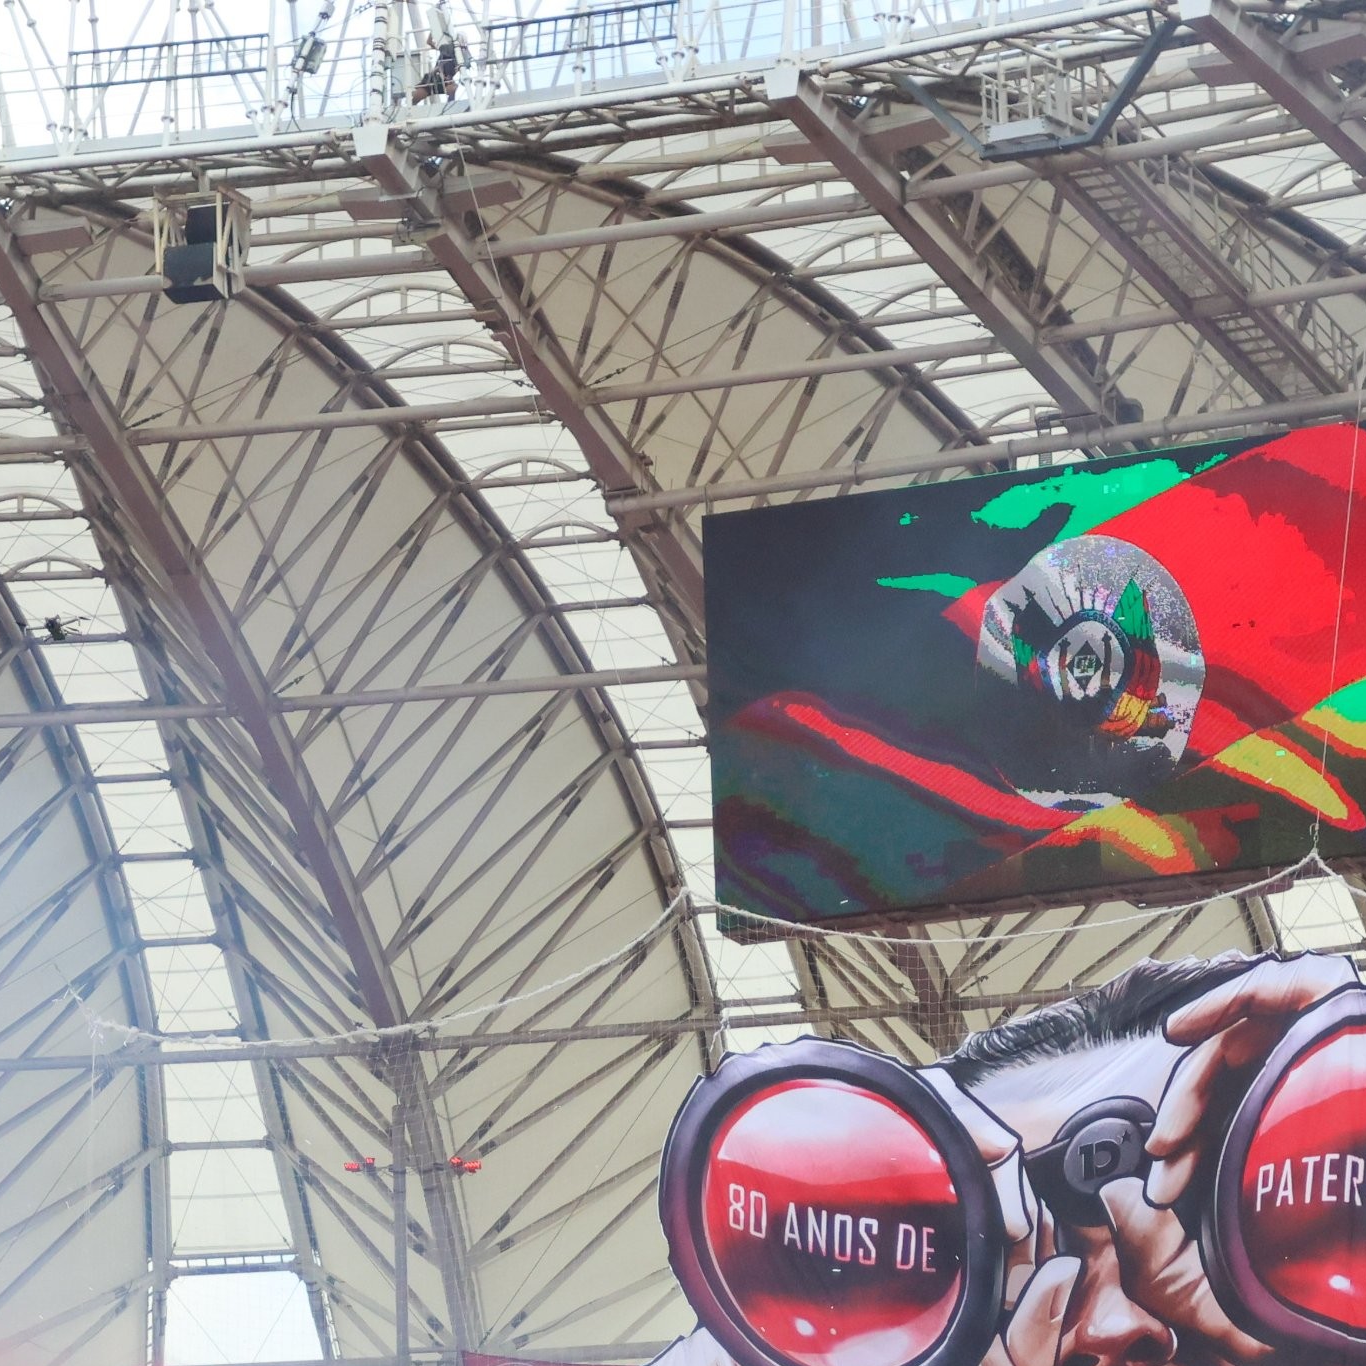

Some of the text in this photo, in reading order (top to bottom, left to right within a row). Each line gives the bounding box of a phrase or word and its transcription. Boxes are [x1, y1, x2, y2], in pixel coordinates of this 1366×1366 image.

[728, 1183, 936, 1273] 80 ANOS DE
